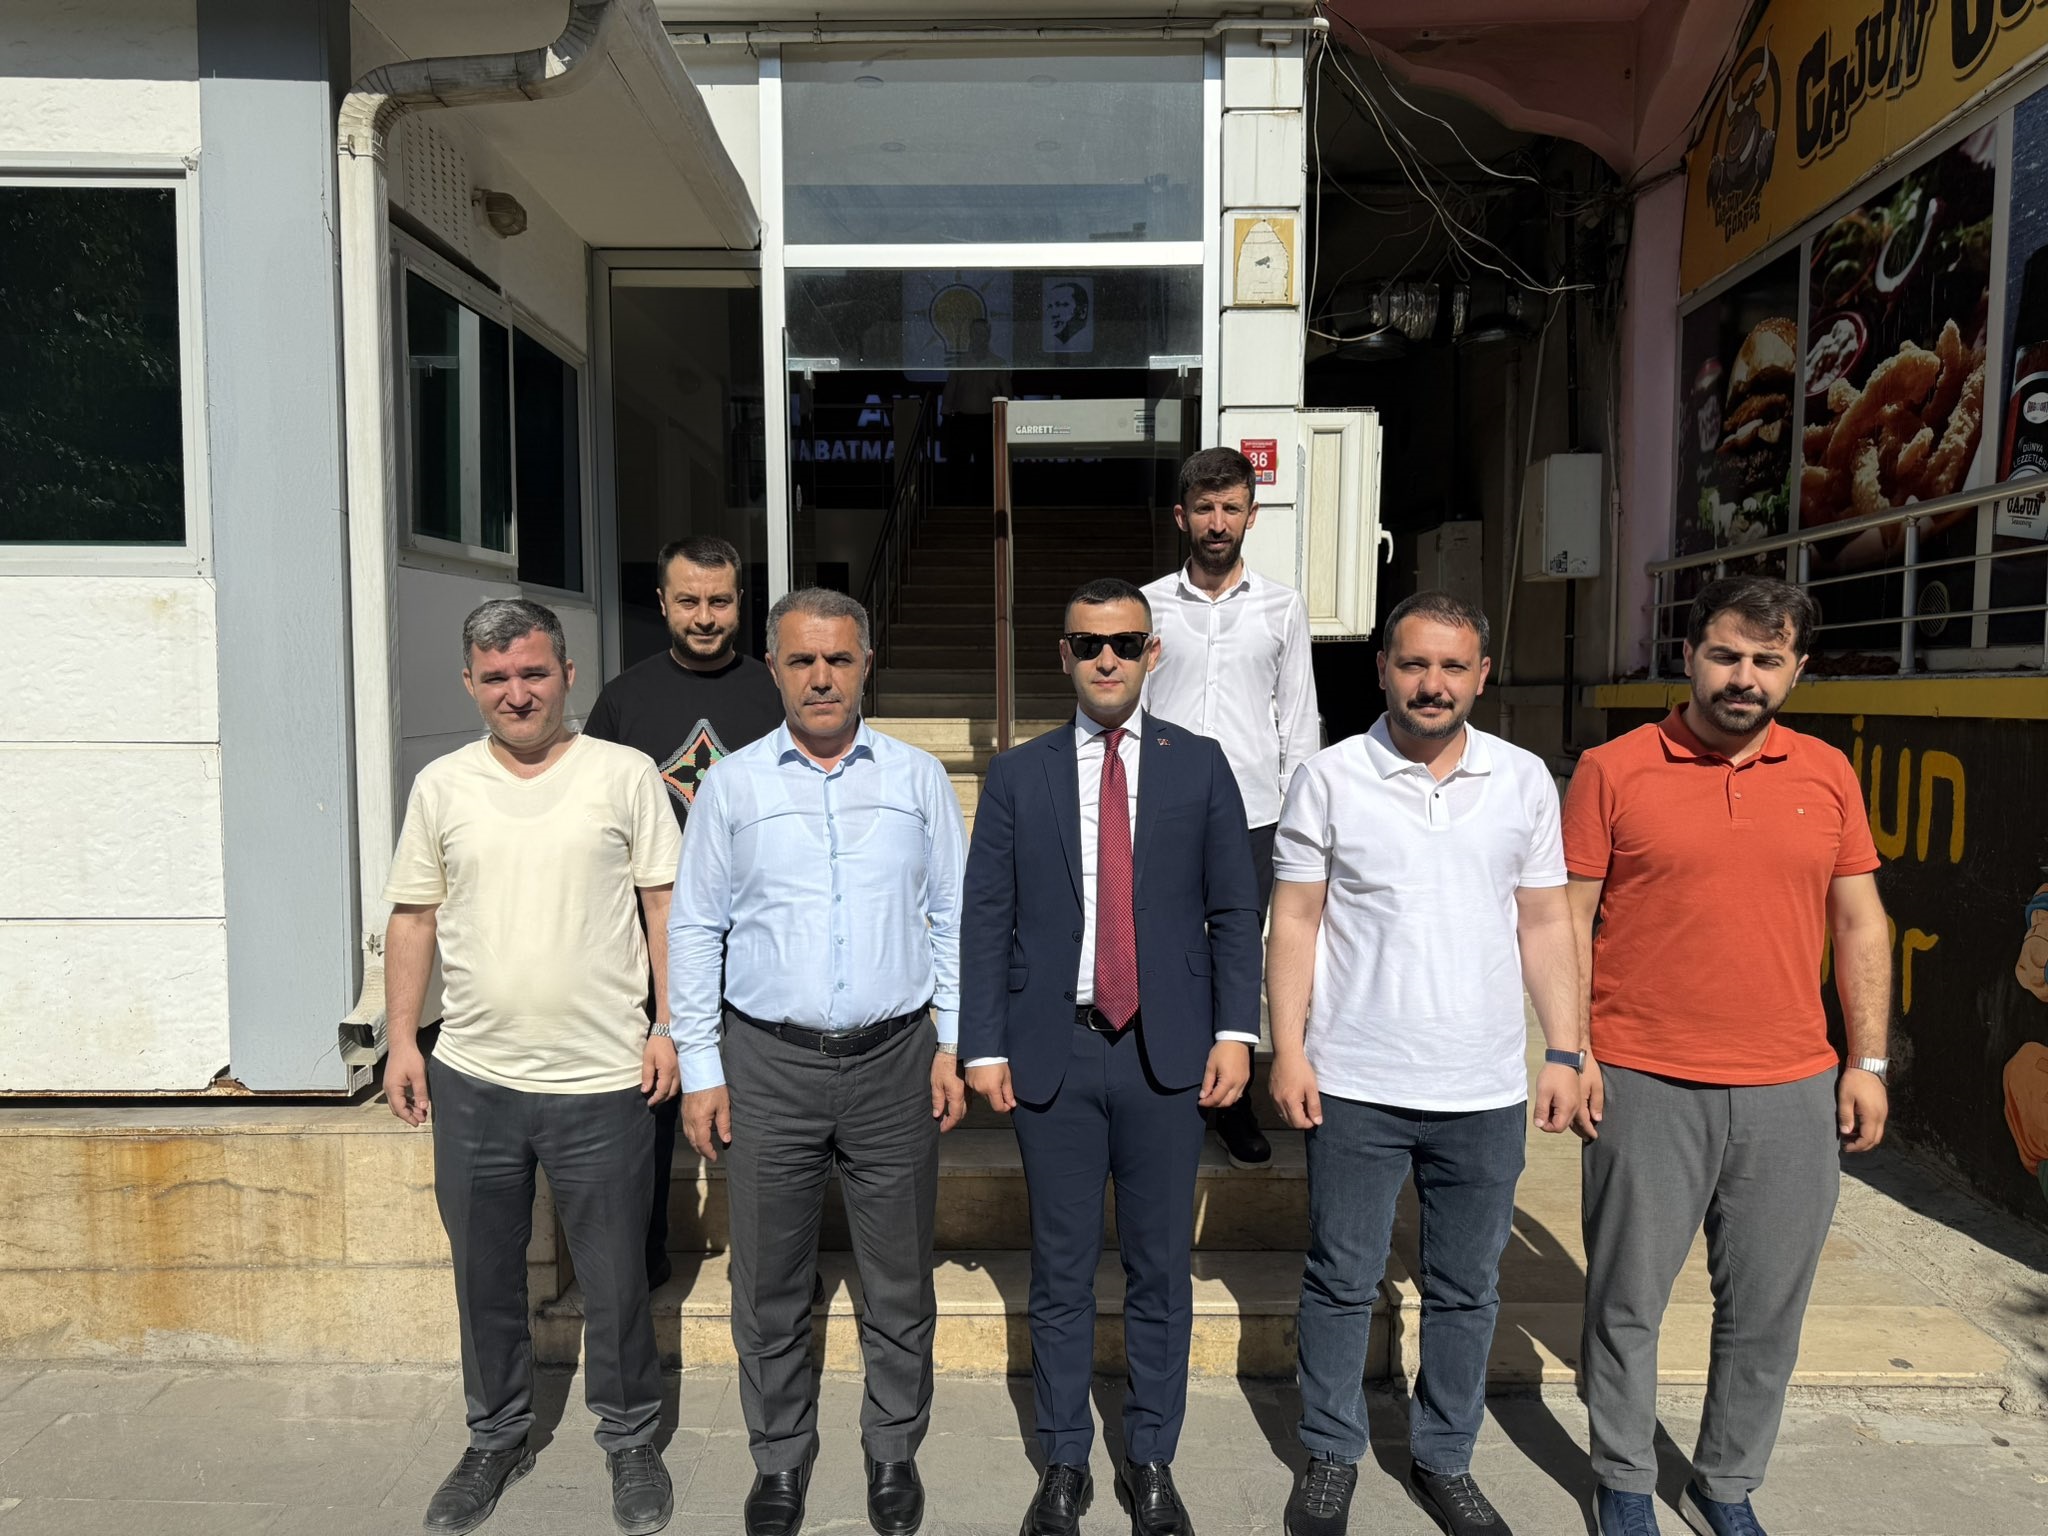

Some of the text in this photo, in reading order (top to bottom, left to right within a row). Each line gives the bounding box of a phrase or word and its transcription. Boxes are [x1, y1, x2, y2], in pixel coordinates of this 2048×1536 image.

[1016, 425, 1054, 434] GARRETT
[1249, 452, 1268, 468] 36
[2007, 496, 2041, 516] CAJUN
